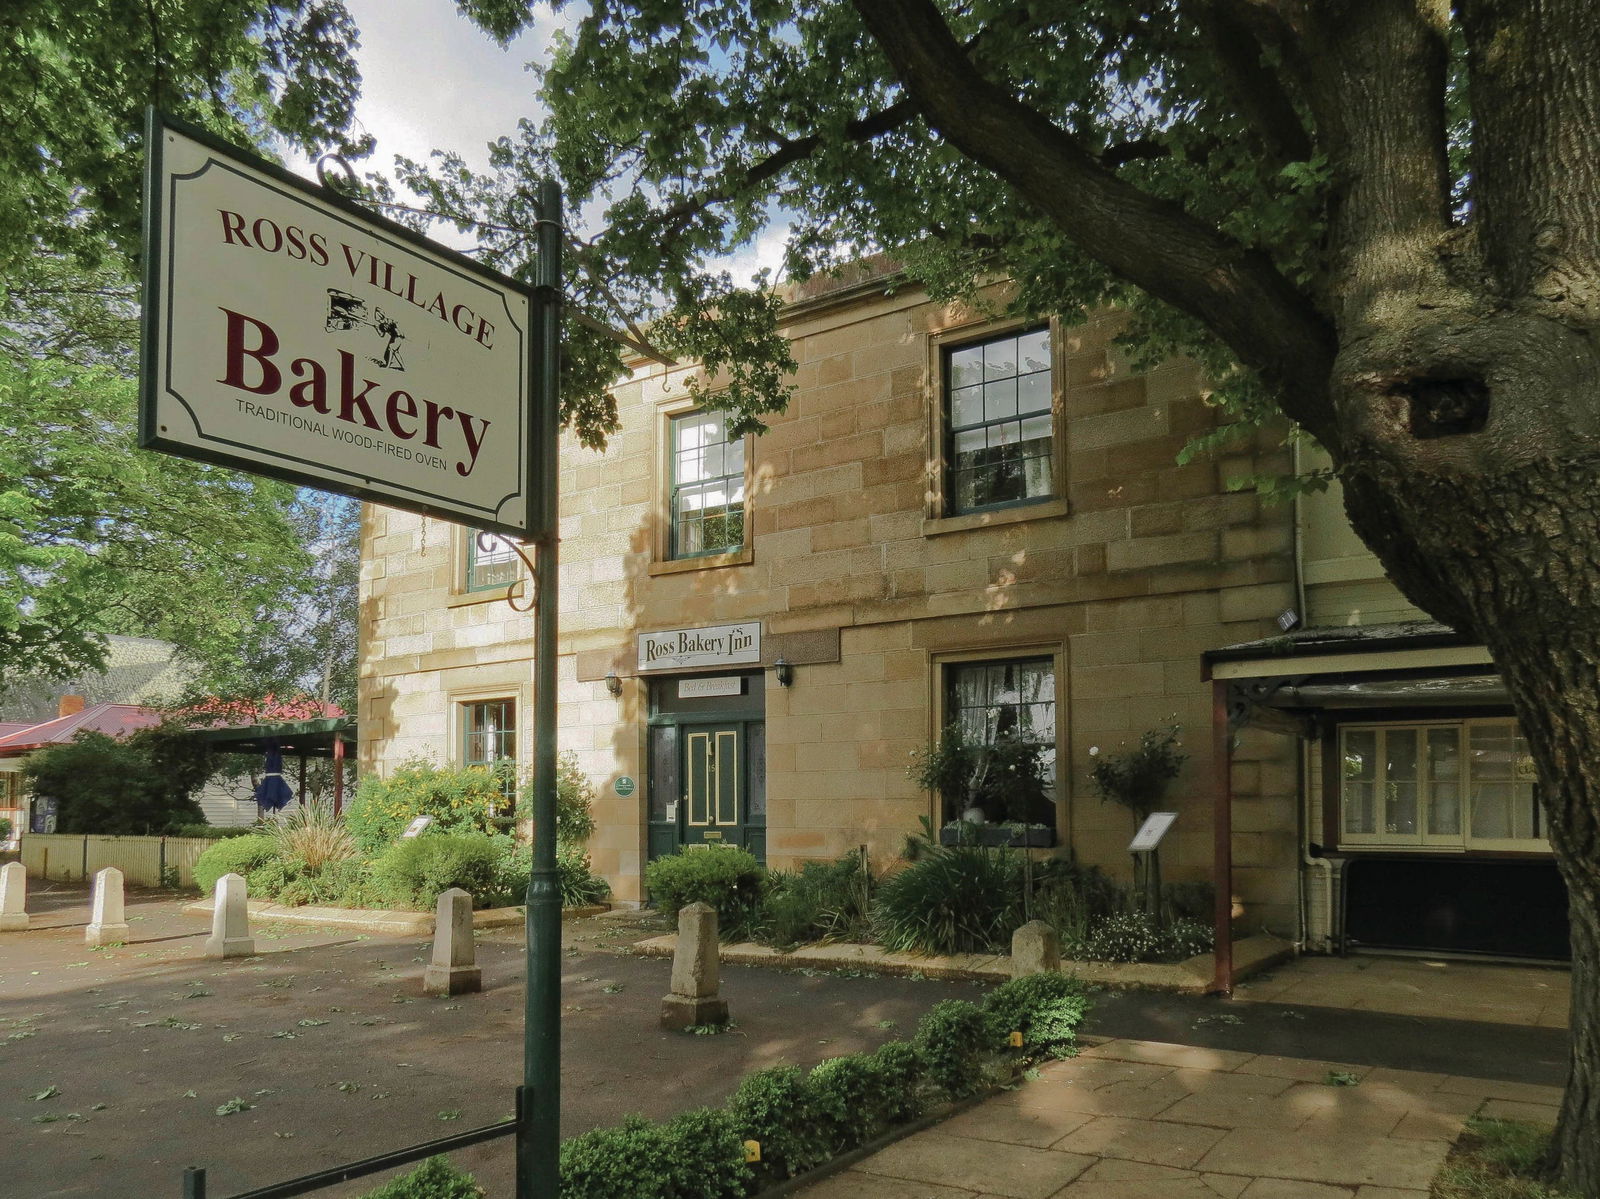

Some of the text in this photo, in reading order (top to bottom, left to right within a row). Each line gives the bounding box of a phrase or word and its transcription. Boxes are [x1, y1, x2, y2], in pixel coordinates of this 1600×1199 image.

[217, 208, 496, 350] ROSS VILLAGE
[216, 306, 491, 477] Bakery
[236, 398, 447, 471] TRADITIONAL WOOD-FIRED OVEN
[645, 632, 753, 662] Ross Bakery Inn
